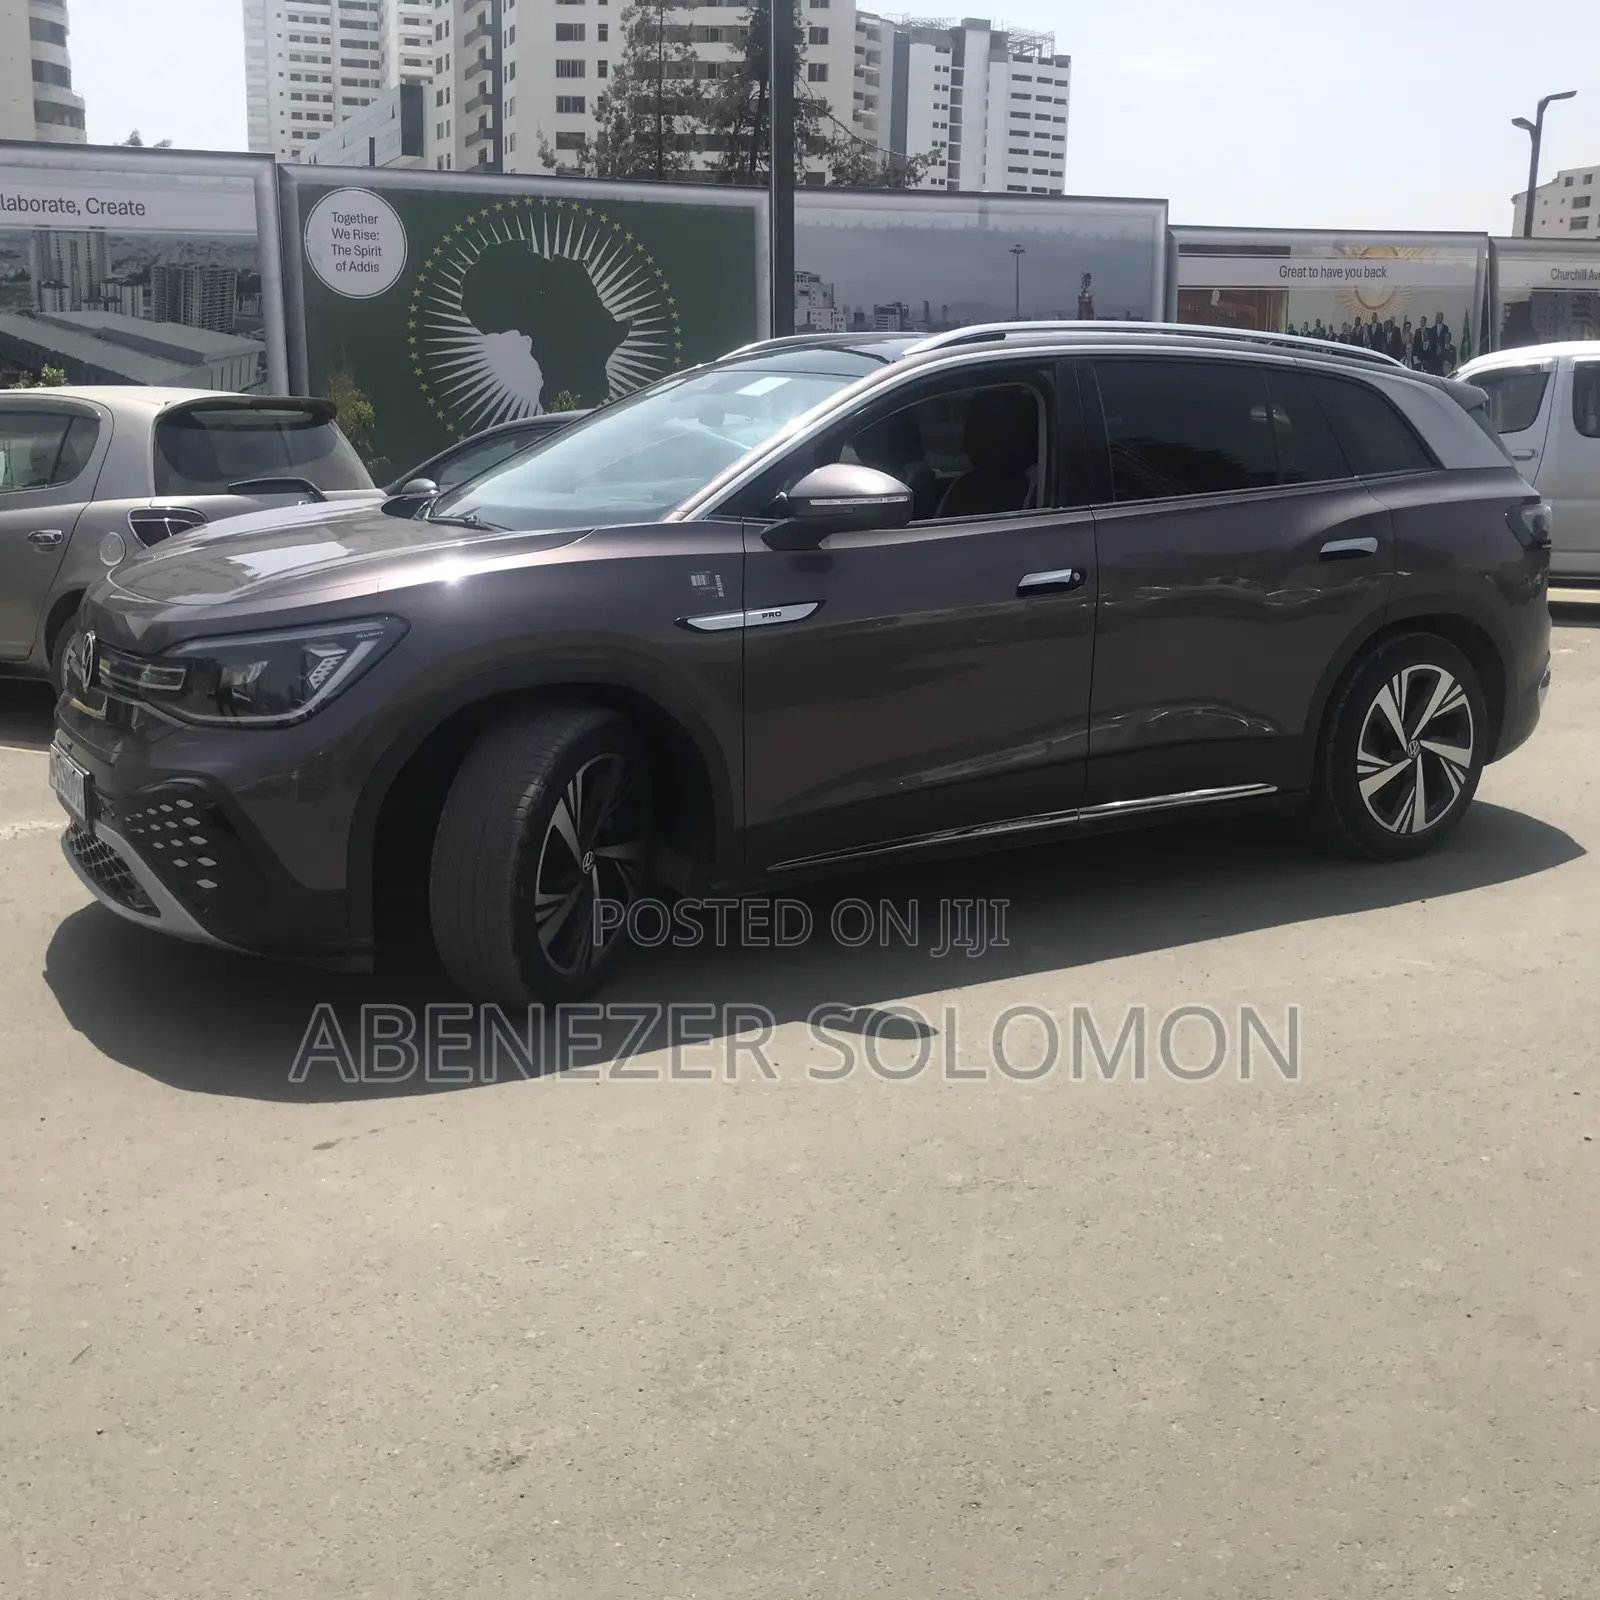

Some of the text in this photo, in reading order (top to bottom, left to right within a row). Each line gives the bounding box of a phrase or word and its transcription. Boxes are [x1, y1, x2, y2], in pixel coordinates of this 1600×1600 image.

[0, 194, 146, 216] laborate, Create
[331, 211, 378, 226] Together
[331, 228, 380, 241] We Rise:
[331, 244, 382, 259] The Spirit
[335, 260, 380, 273] of Addis
[1279, 265, 1387, 281] Great to have you back
[1551, 268, 1587, 281] Churchill
